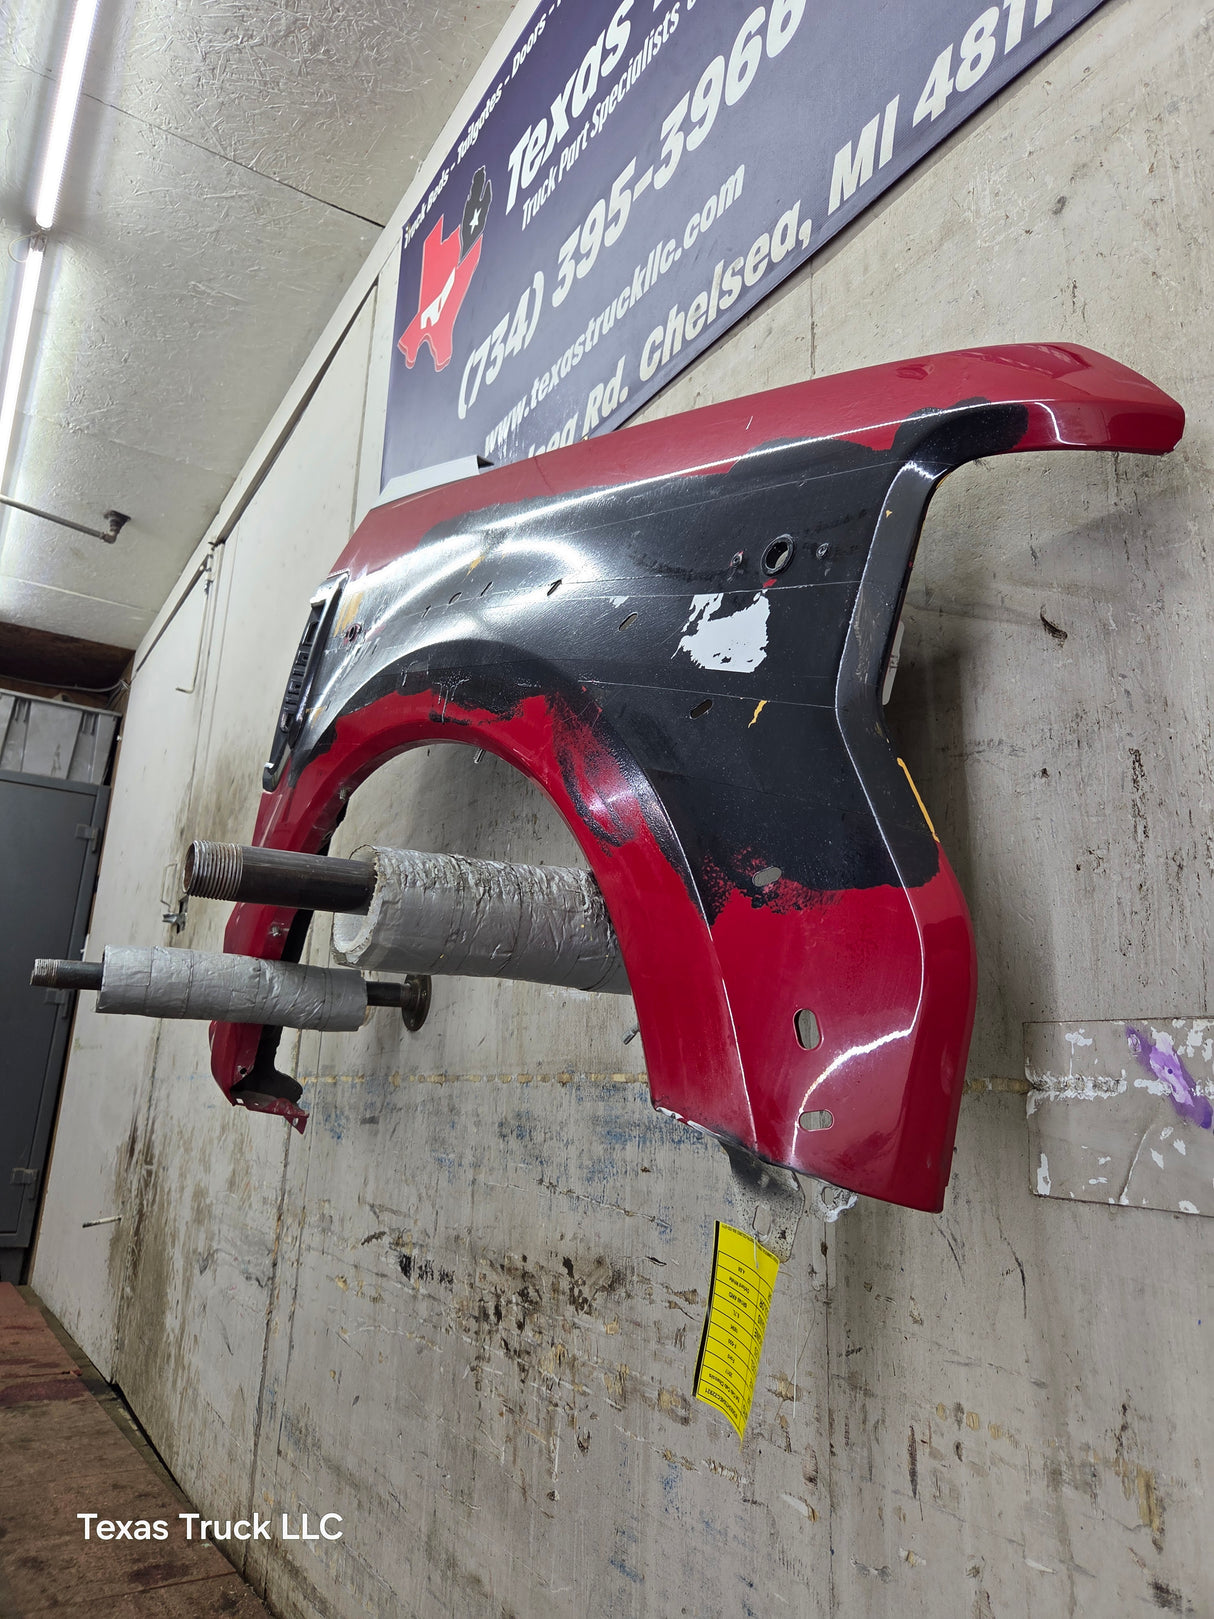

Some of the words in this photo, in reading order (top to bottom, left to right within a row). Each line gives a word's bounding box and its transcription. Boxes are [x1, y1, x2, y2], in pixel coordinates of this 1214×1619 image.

[456, 82, 503, 165] Tailgates
[511, 13, 547, 79] Doors
[457, 271, 545, 420] (734)
[552, 0, 806, 308] 395-3966
[505, 0, 635, 216] Texas
[521, 164, 558, 232] Truck
[557, 121, 590, 184] Part
[590, 2, 680, 138] Specialists
[484, 164, 746, 459] www.texastruckllc.com
[582, 354, 630, 438] Rd.
[639, 199, 813, 382] Chelsea,
[827, 93, 900, 216] MI
